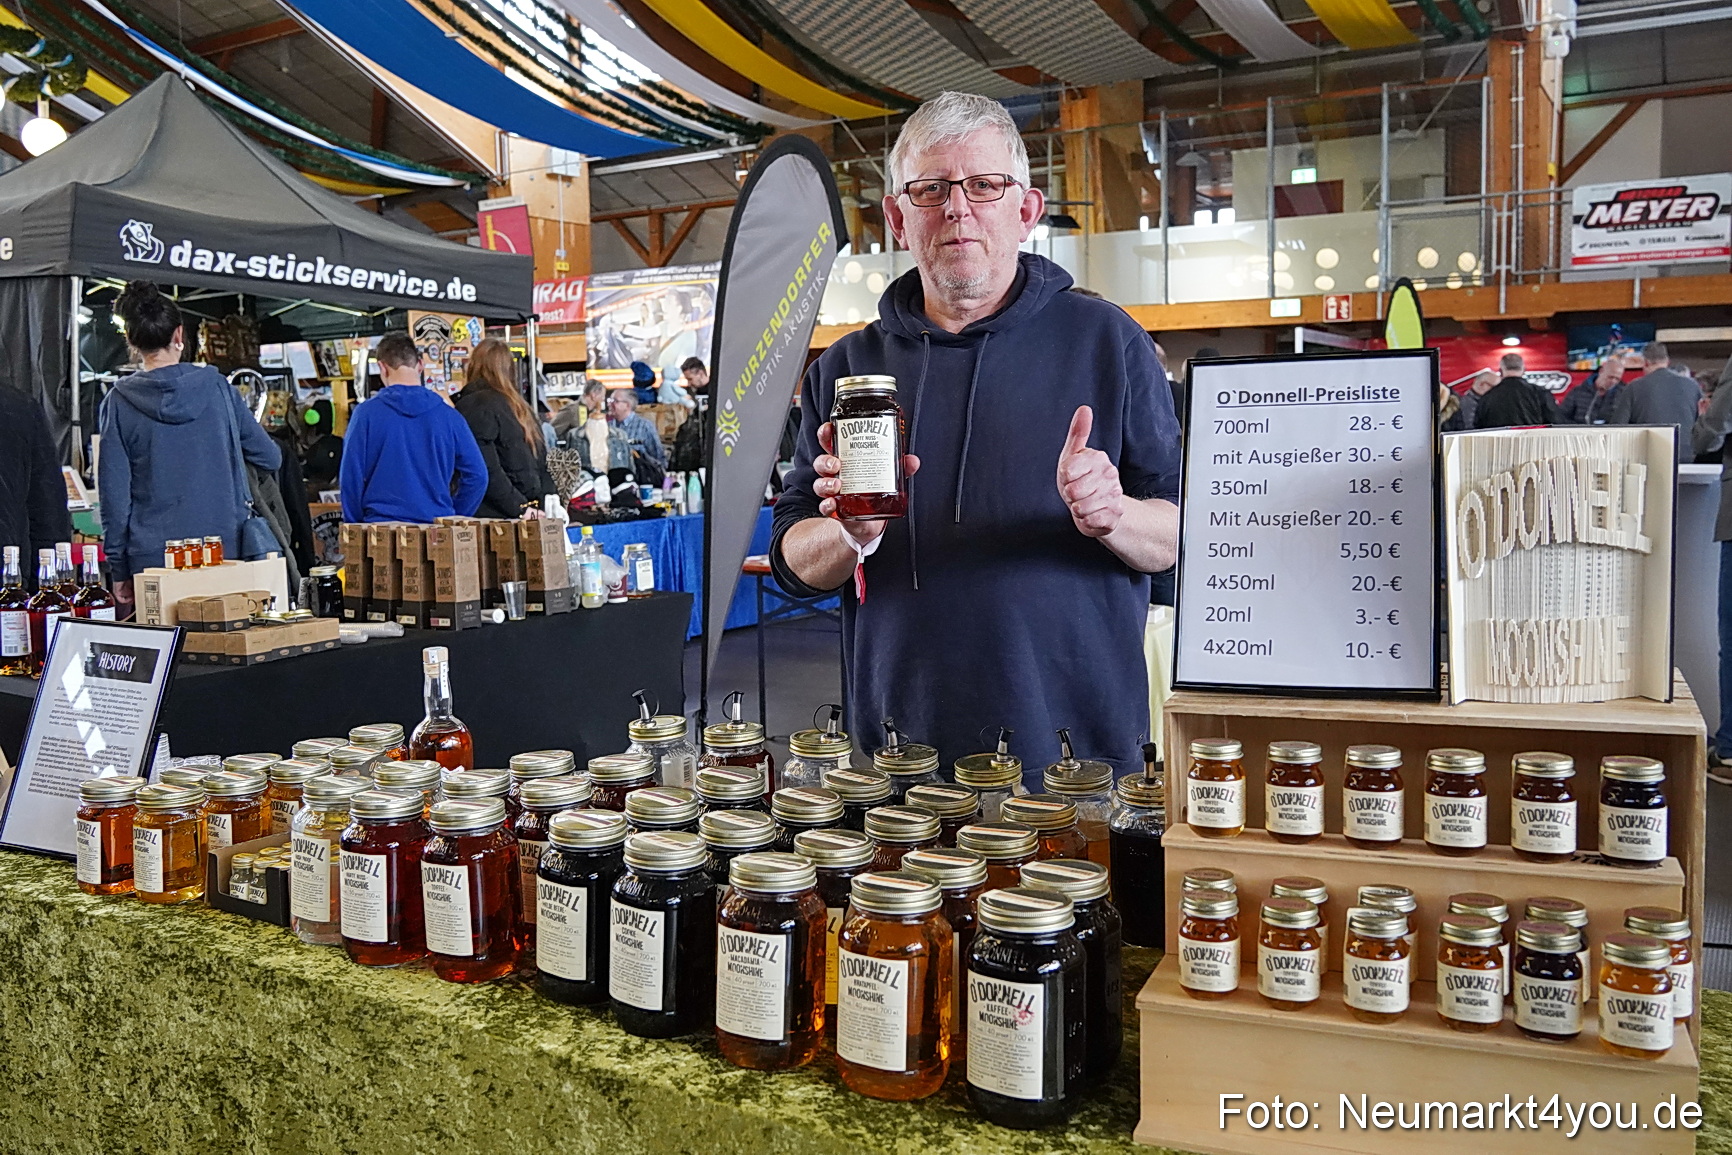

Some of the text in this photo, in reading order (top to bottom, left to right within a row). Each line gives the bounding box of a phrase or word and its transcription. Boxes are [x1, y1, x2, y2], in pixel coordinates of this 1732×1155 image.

[1586, 196, 1716, 226] MEYER
[169, 240, 477, 302] dax-stickservice.de
[733, 222, 832, 402] KURZENDORFER
[1213, 414, 1403, 434] 700ml 28.- €
[1213, 446, 1402, 467] mit Ausgießer 30.- €
[1211, 478, 1403, 495] 350ml 18.- €
[1210, 510, 1403, 529] Mit Ausgießer 20.- €
[1208, 542, 1401, 561] 50ml 5,50 €
[1206, 574, 1275, 590] 4x50ml
[1205, 606, 1400, 625] 20ml 3.- €
[1204, 639, 1402, 659] 4x20ml 10.- €
[1486, 615, 1631, 688] MOONSHINE
[99, 651, 137, 674] HISTORY
[730, 954, 760, 965] MACADAMIA
[986, 1003, 1009, 1016] KAFFEE
